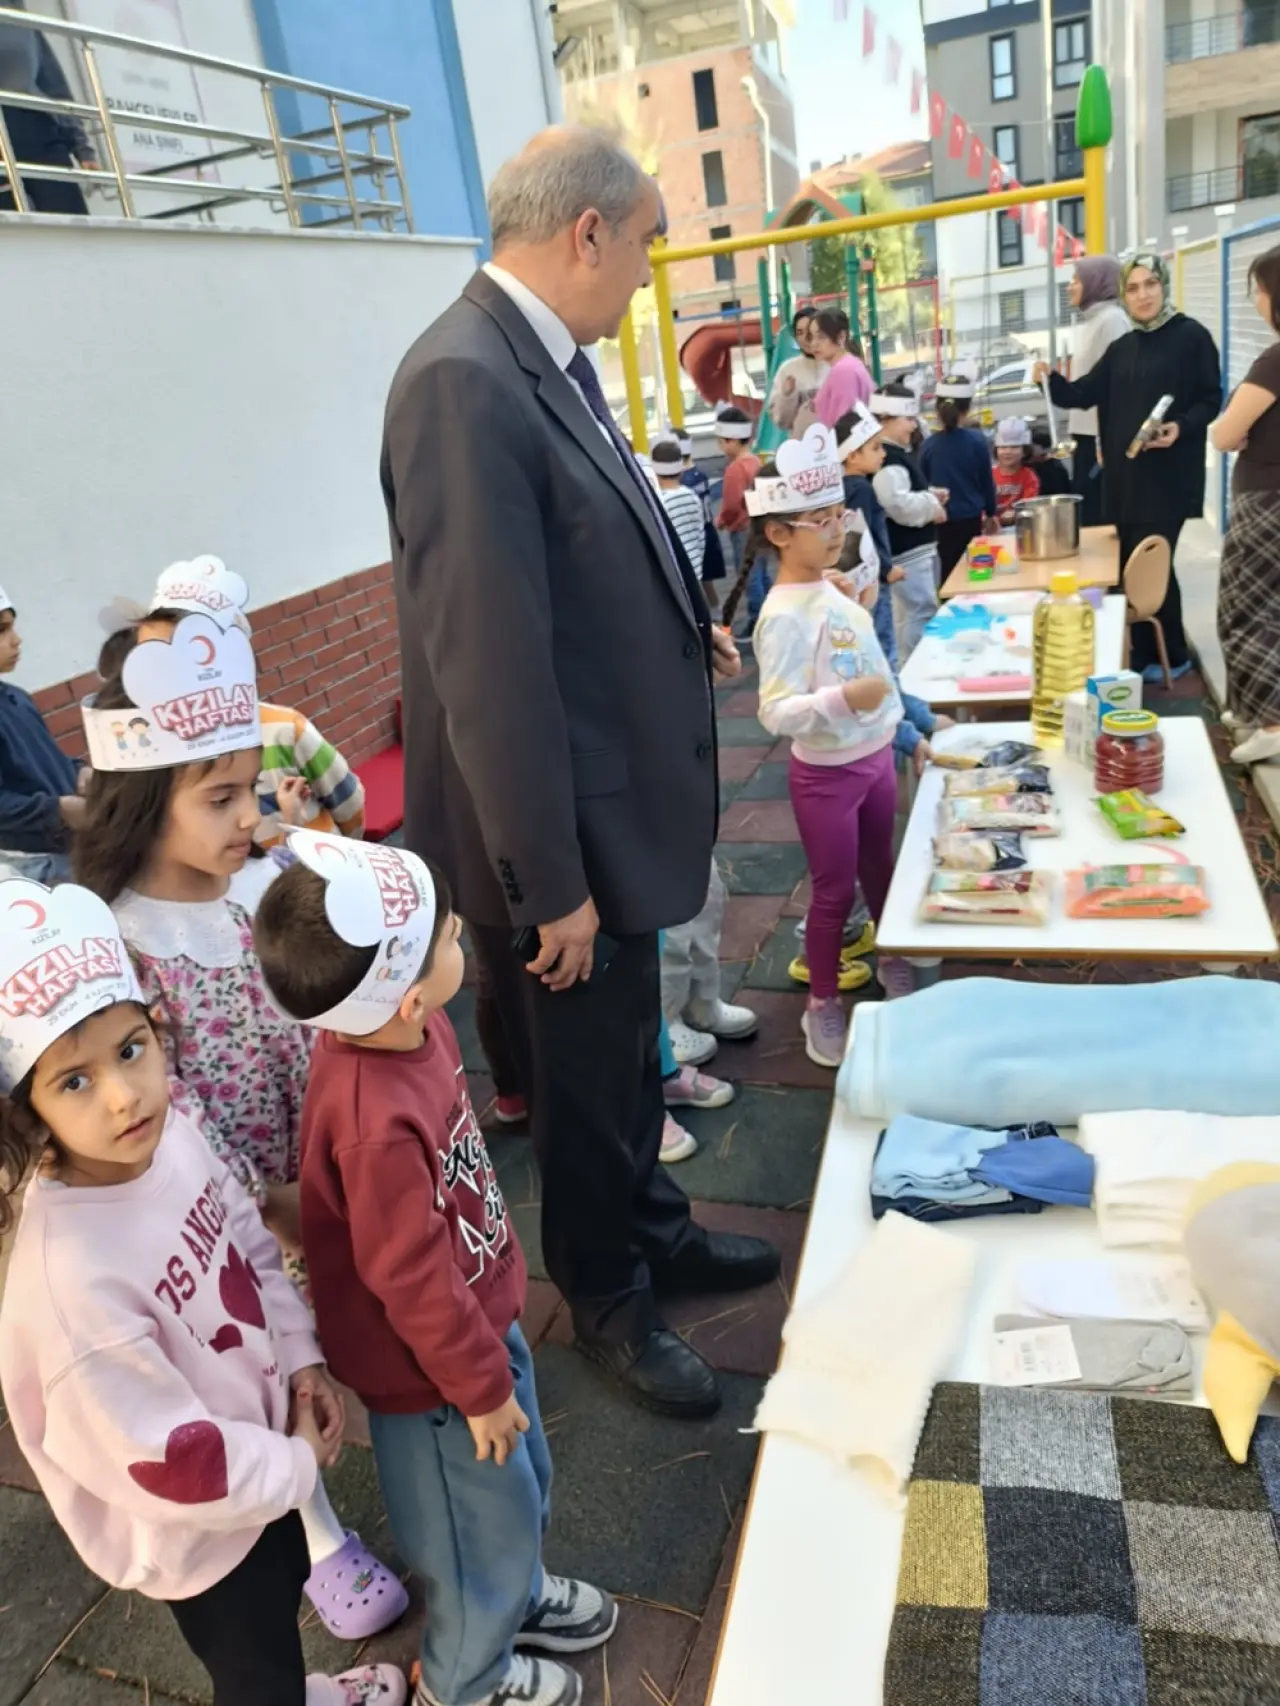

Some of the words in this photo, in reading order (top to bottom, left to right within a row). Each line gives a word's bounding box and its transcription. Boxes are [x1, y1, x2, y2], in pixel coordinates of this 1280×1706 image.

[152, 684, 254, 731] KIZILAY
[175, 705, 254, 741] HAFTASI
[0, 937, 120, 1017] KIZILAY
[24, 956, 123, 1017] HAFTASI
